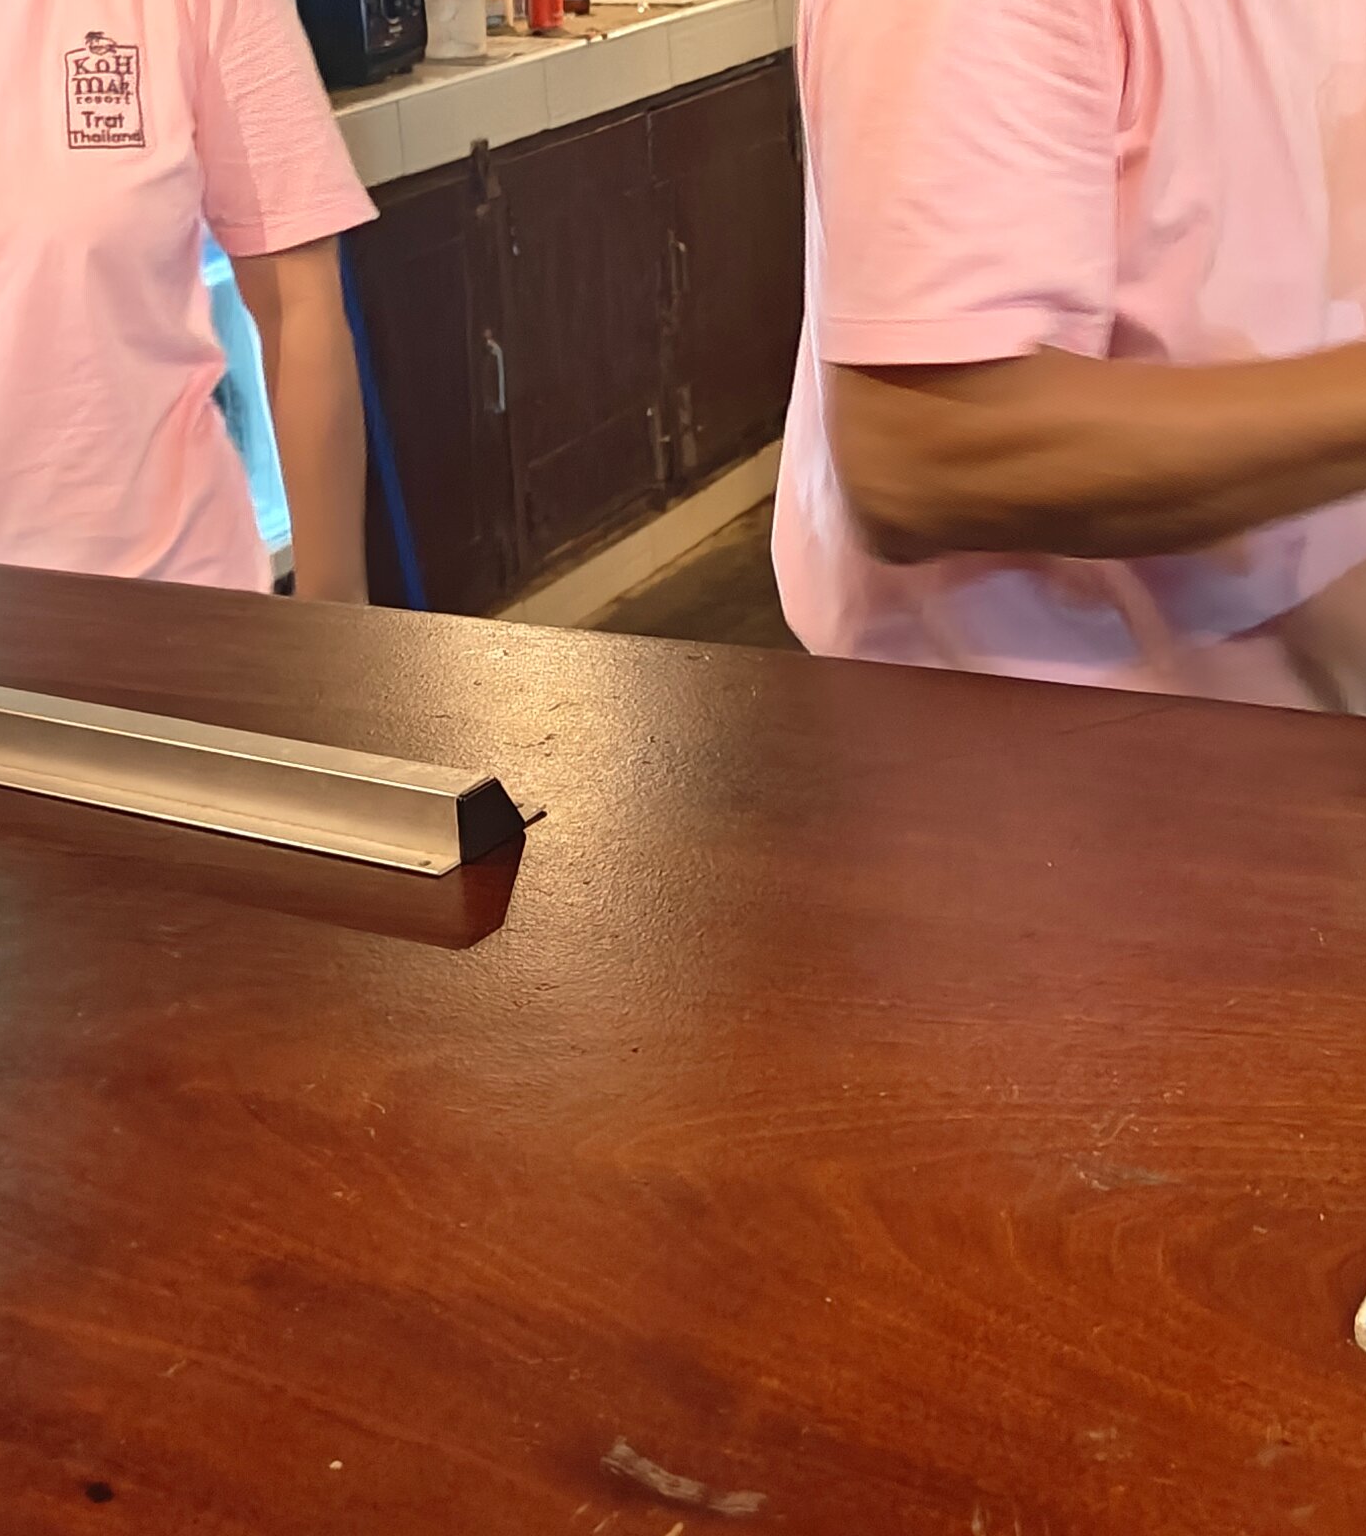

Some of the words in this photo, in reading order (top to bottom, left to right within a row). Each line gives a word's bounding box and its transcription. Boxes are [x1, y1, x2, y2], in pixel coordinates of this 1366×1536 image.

[76, 94, 132, 105] resort
[81, 111, 125, 128] Trat
[70, 130, 142, 143] Thailand
